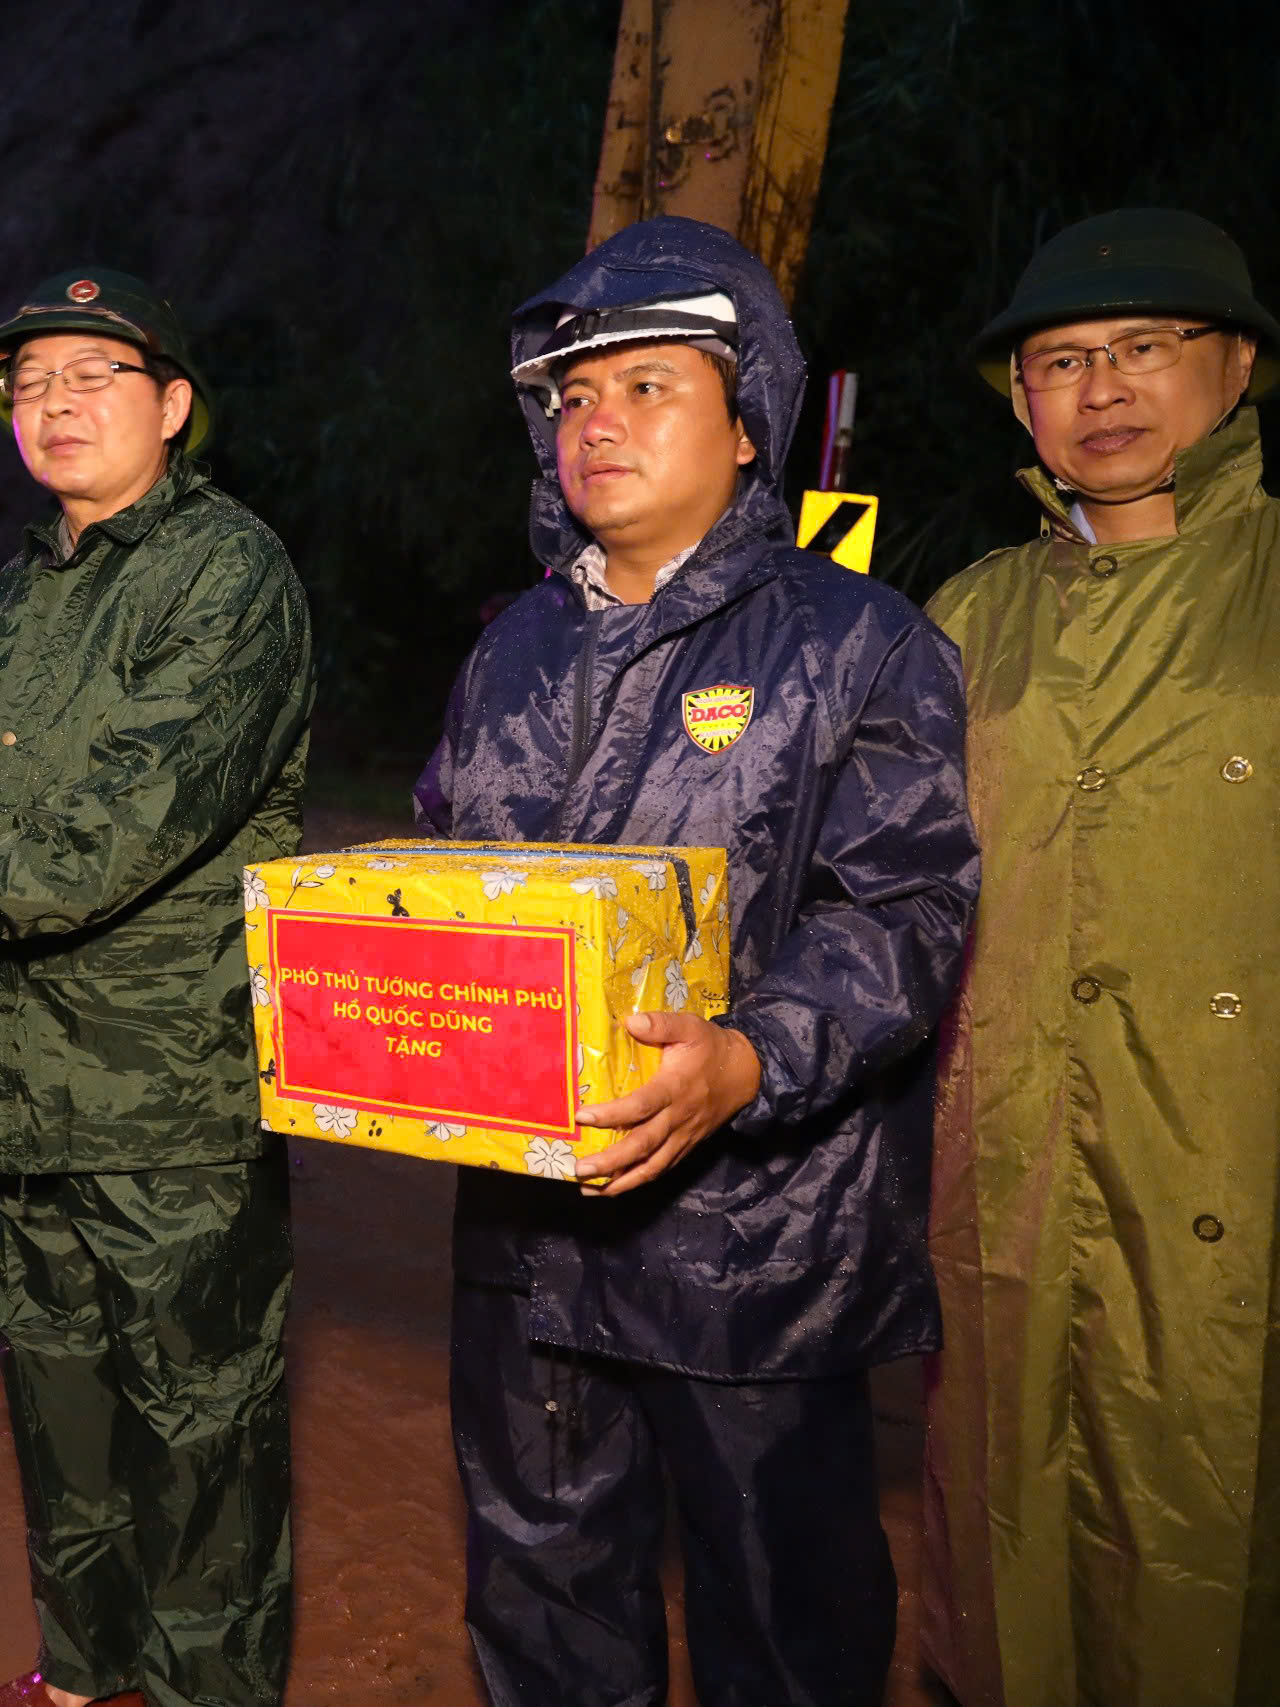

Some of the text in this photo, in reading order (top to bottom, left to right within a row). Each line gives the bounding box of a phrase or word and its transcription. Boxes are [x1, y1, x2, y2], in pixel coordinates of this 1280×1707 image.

[690, 703, 746, 722] DACO
[281, 966, 563, 1010] PHÓ THỦ TƯỚNG CHÍNH PHỦ
[333, 998, 493, 1033] HỒ QUỐC DŨNG
[385, 1035, 442, 1060] TẶNG
